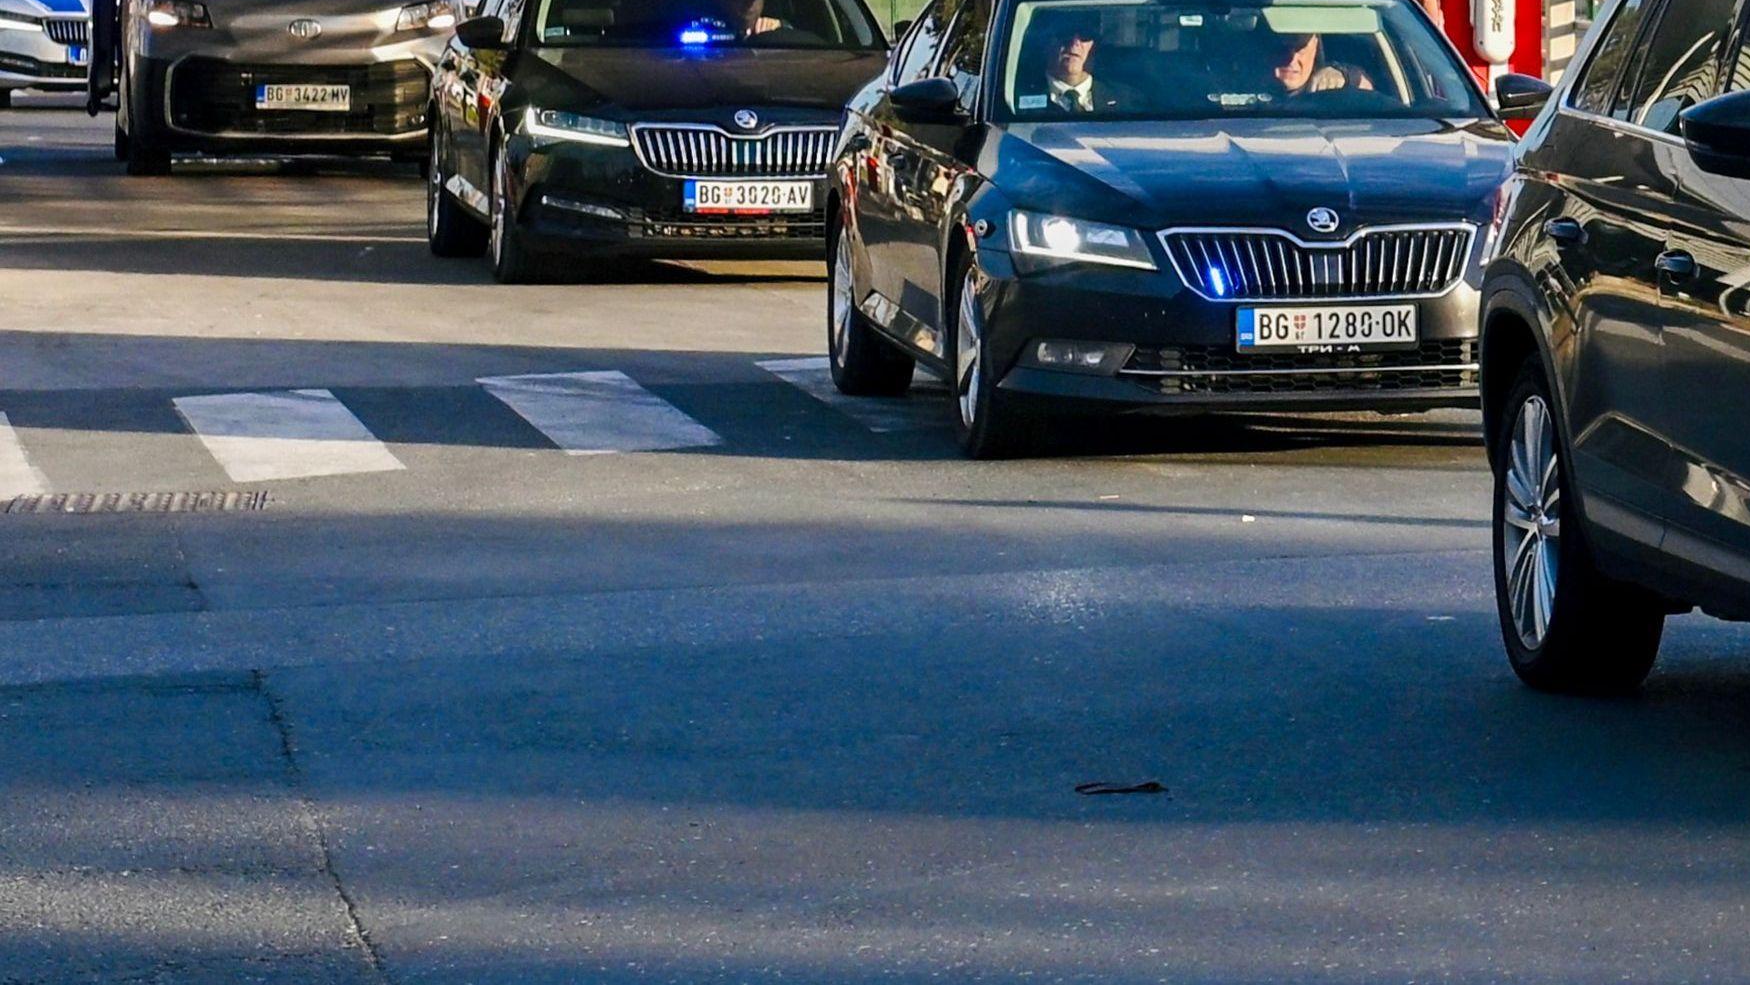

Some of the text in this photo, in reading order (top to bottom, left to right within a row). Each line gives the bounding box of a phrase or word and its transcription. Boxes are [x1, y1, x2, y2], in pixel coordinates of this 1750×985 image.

[267, 87, 283, 101] BG
[699, 185, 721, 204] BG
[1259, 313, 1289, 340] BG
